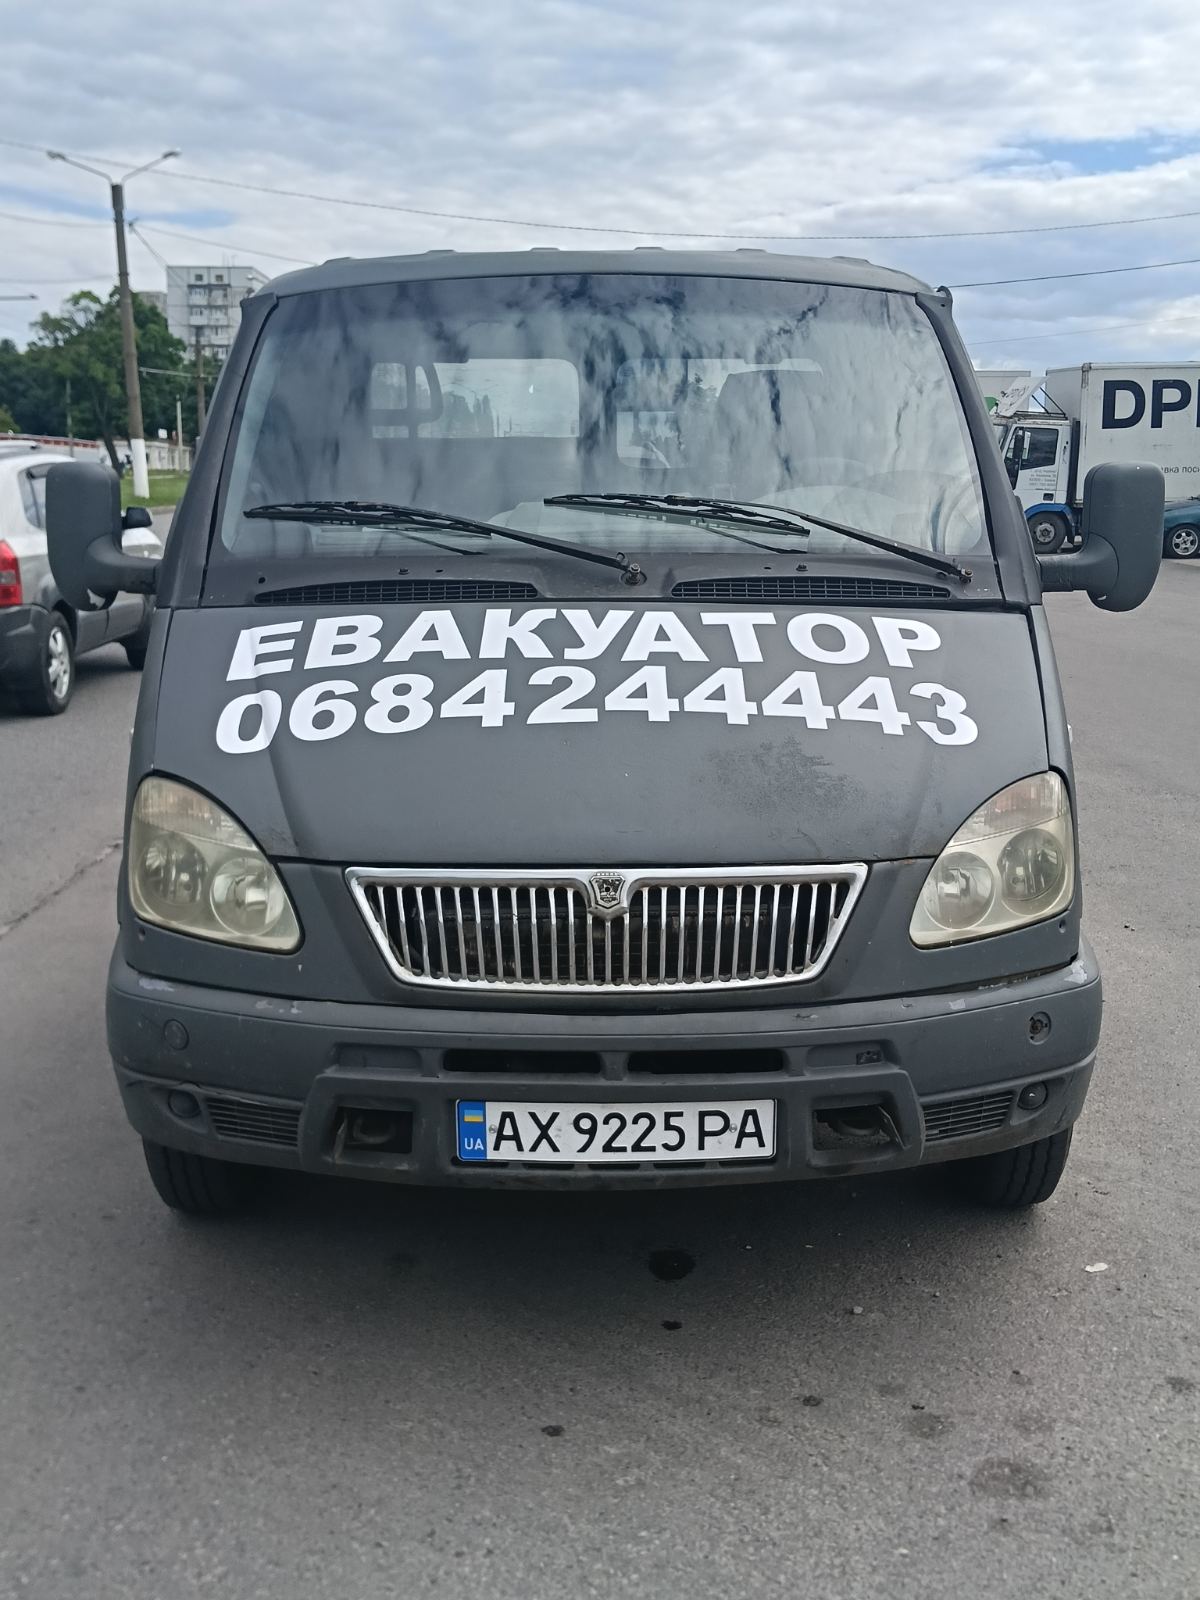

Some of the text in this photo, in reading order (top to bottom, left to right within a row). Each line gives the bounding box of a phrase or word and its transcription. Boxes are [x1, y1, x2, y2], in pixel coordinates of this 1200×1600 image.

[1102, 379, 1200, 429] DP
[226, 608, 942, 682] ЕВАКУАТОР
[215, 665, 979, 754] 0684244443
[464, 1137, 485, 1151] UA
[493, 1108, 766, 1153] AX 9225 PA
